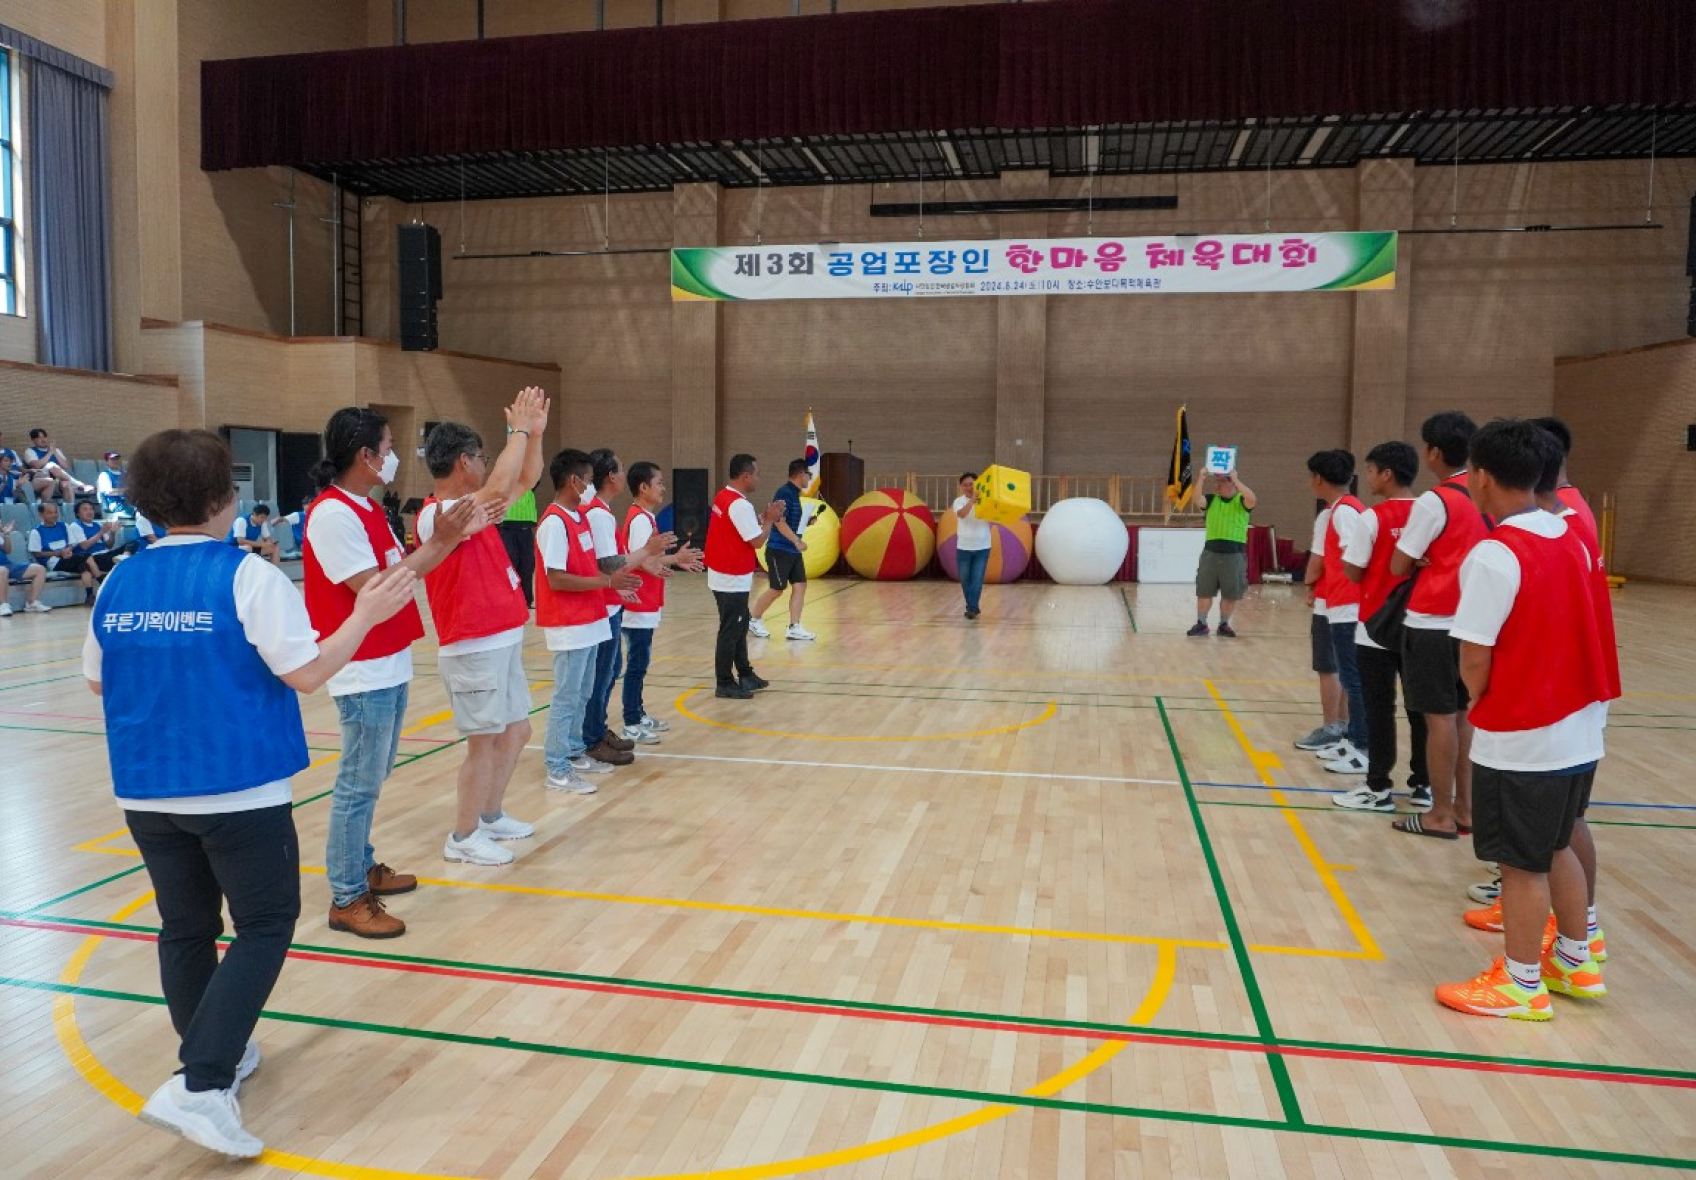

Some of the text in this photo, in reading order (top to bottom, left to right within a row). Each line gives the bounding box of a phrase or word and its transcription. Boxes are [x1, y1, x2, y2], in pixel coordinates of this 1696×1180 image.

[734, 239, 1317, 277] 제3회 공업포장인 한마음 체육대회
[1212, 450, 1231, 471] 짝
[102, 611, 213, 633] 푸른기획이벤트
